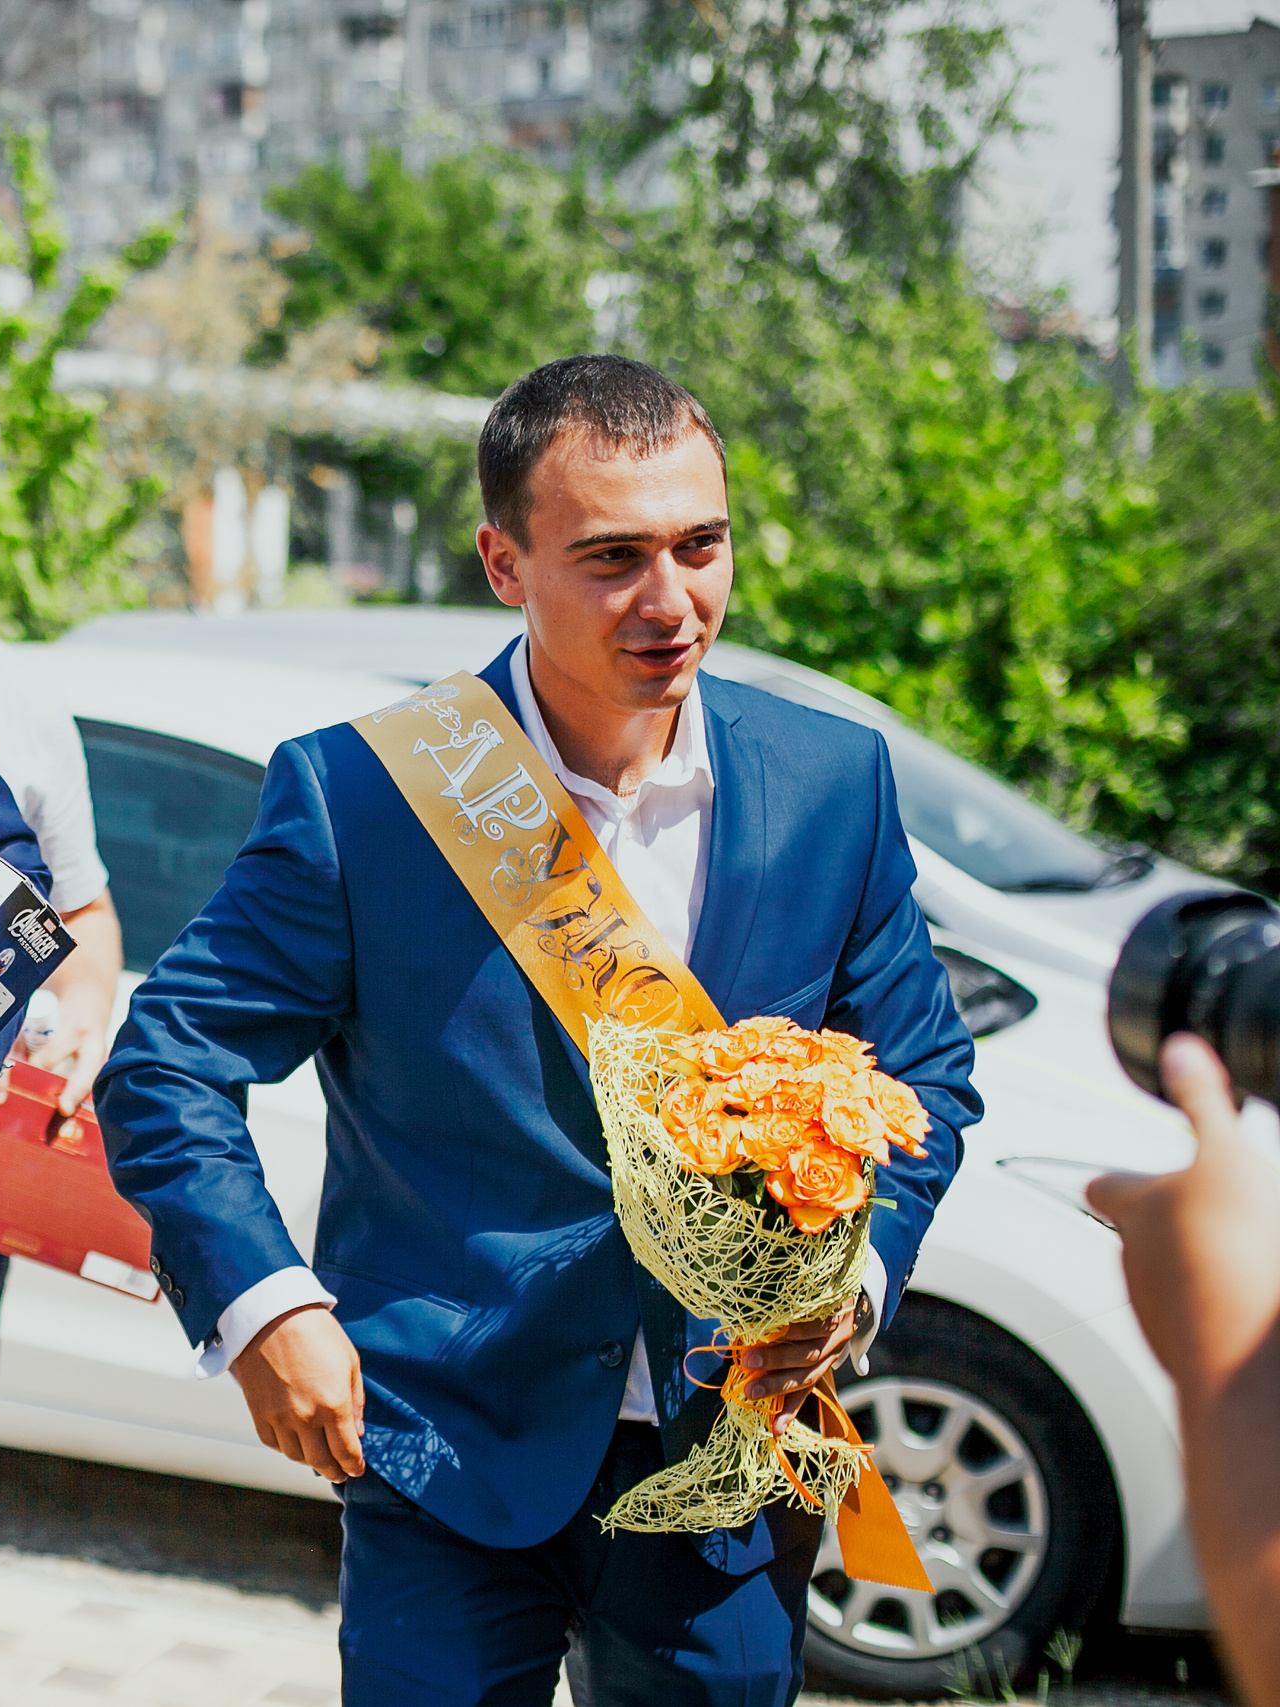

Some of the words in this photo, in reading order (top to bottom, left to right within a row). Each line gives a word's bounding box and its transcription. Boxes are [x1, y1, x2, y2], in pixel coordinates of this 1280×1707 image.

[412, 718, 706, 1045] ДРУЖО
[7, 908, 60, 960] AVENGERS
[17, 937, 42, 964] ASSEMBLE
